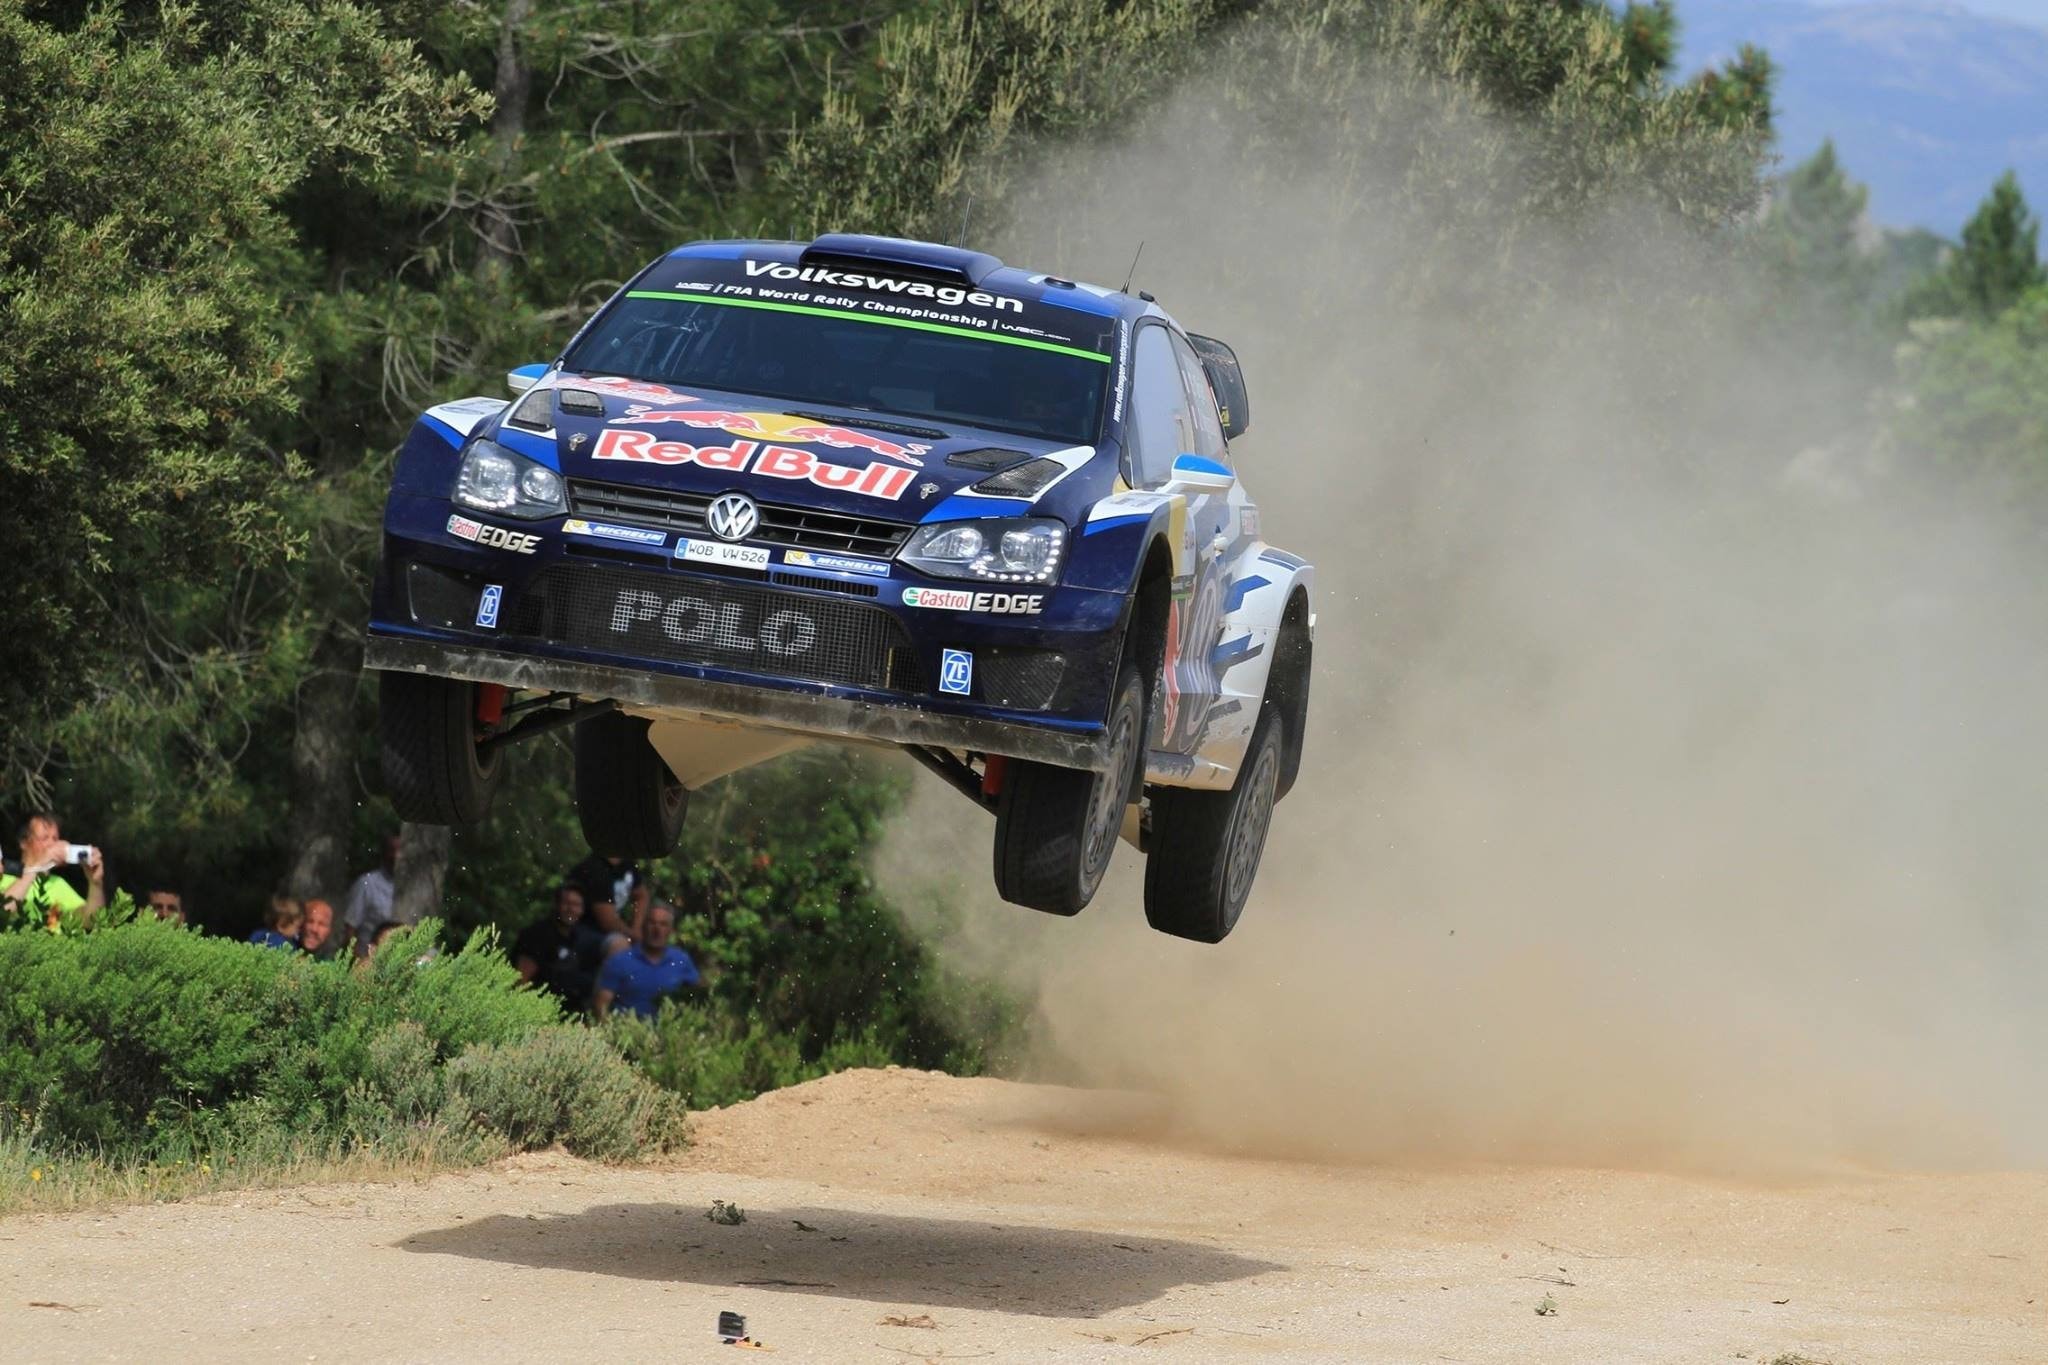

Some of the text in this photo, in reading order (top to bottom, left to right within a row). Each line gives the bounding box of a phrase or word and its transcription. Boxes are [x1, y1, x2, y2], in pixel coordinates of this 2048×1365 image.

[745, 259, 1024, 314] Volkswagen
[723, 285, 753, 296] FIA
[758, 288, 810, 301] World
[813, 294, 860, 309] Rally
[863, 301, 988, 328] Championship
[477, 525, 544, 554] EDGE
[593, 525, 664, 542] MICHELIN
[688, 543, 714, 557] WOB
[815, 556, 888, 573] MICHELIN
[920, 590, 1044, 615] Castrol EDGE
[609, 588, 817, 656] POLO
